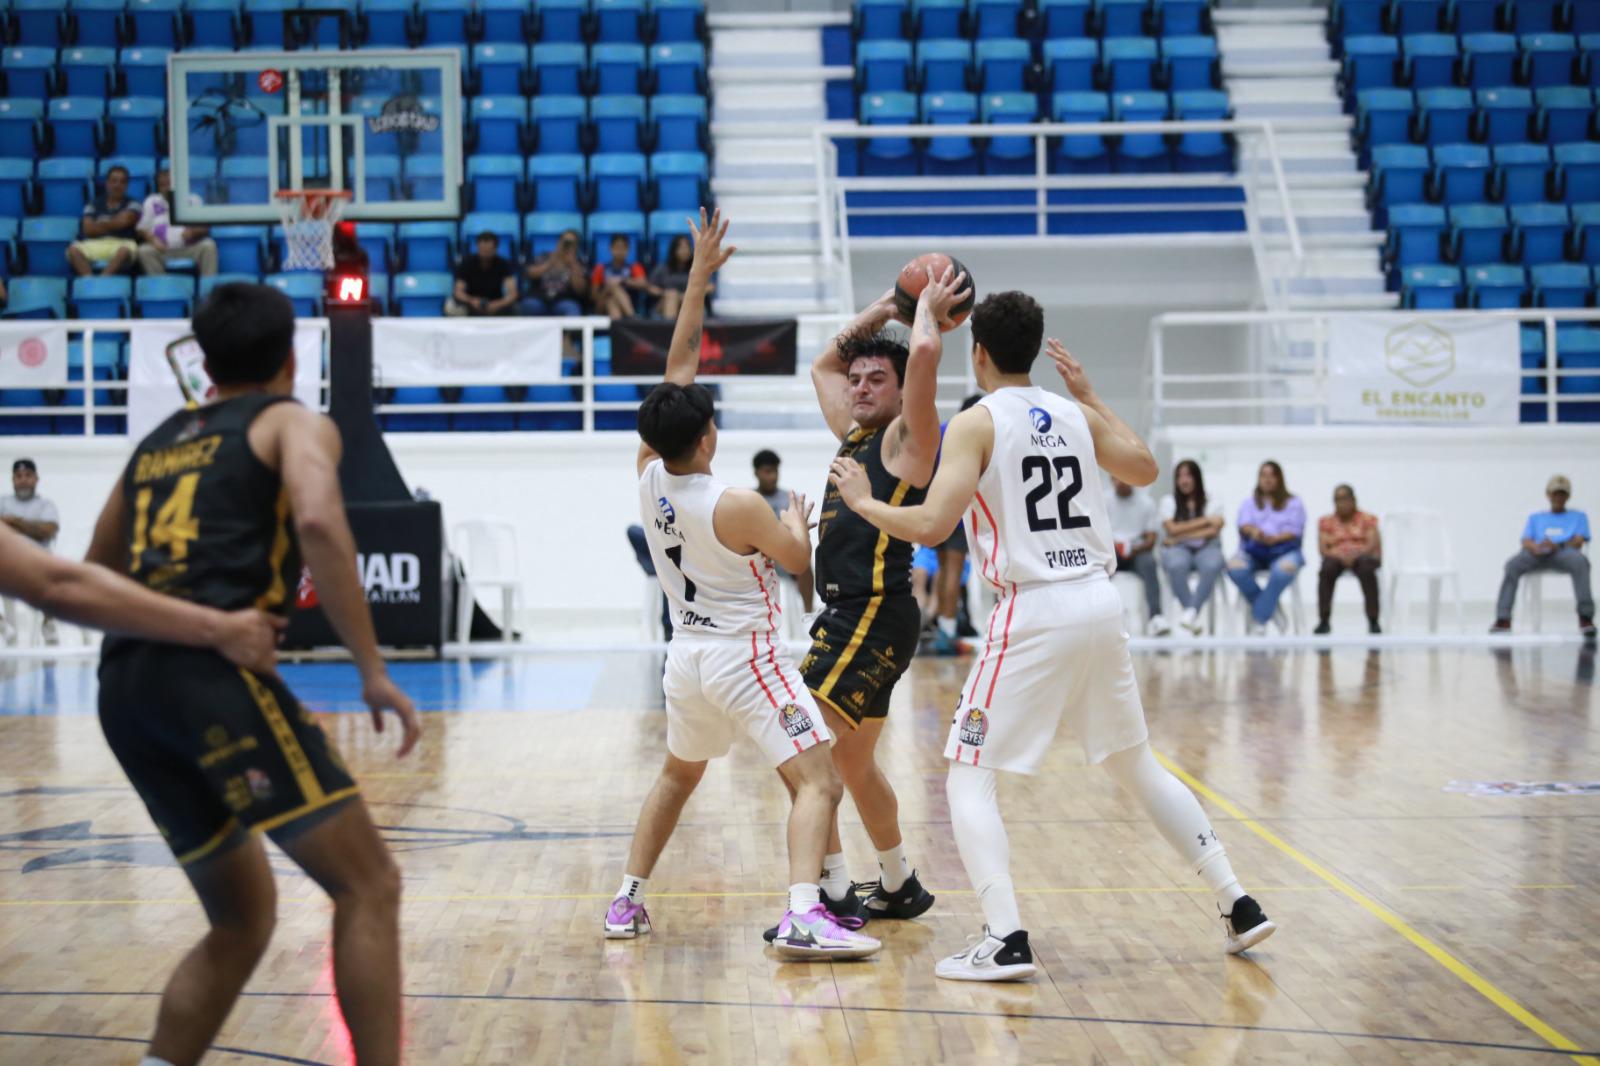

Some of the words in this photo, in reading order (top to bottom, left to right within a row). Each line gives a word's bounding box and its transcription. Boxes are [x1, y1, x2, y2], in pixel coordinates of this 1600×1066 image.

[1362, 391, 1383, 406] EL
[1391, 391, 1486, 408] ENCANTO
[1031, 434, 1067, 447] NEGA
[1022, 456, 1091, 532] 22
[131, 472, 200, 571] 14
[1045, 548, 1087, 568] FLORES
[665, 544, 697, 602] 7
[786, 716, 813, 737] REYES
[960, 728, 984, 746] REYES
